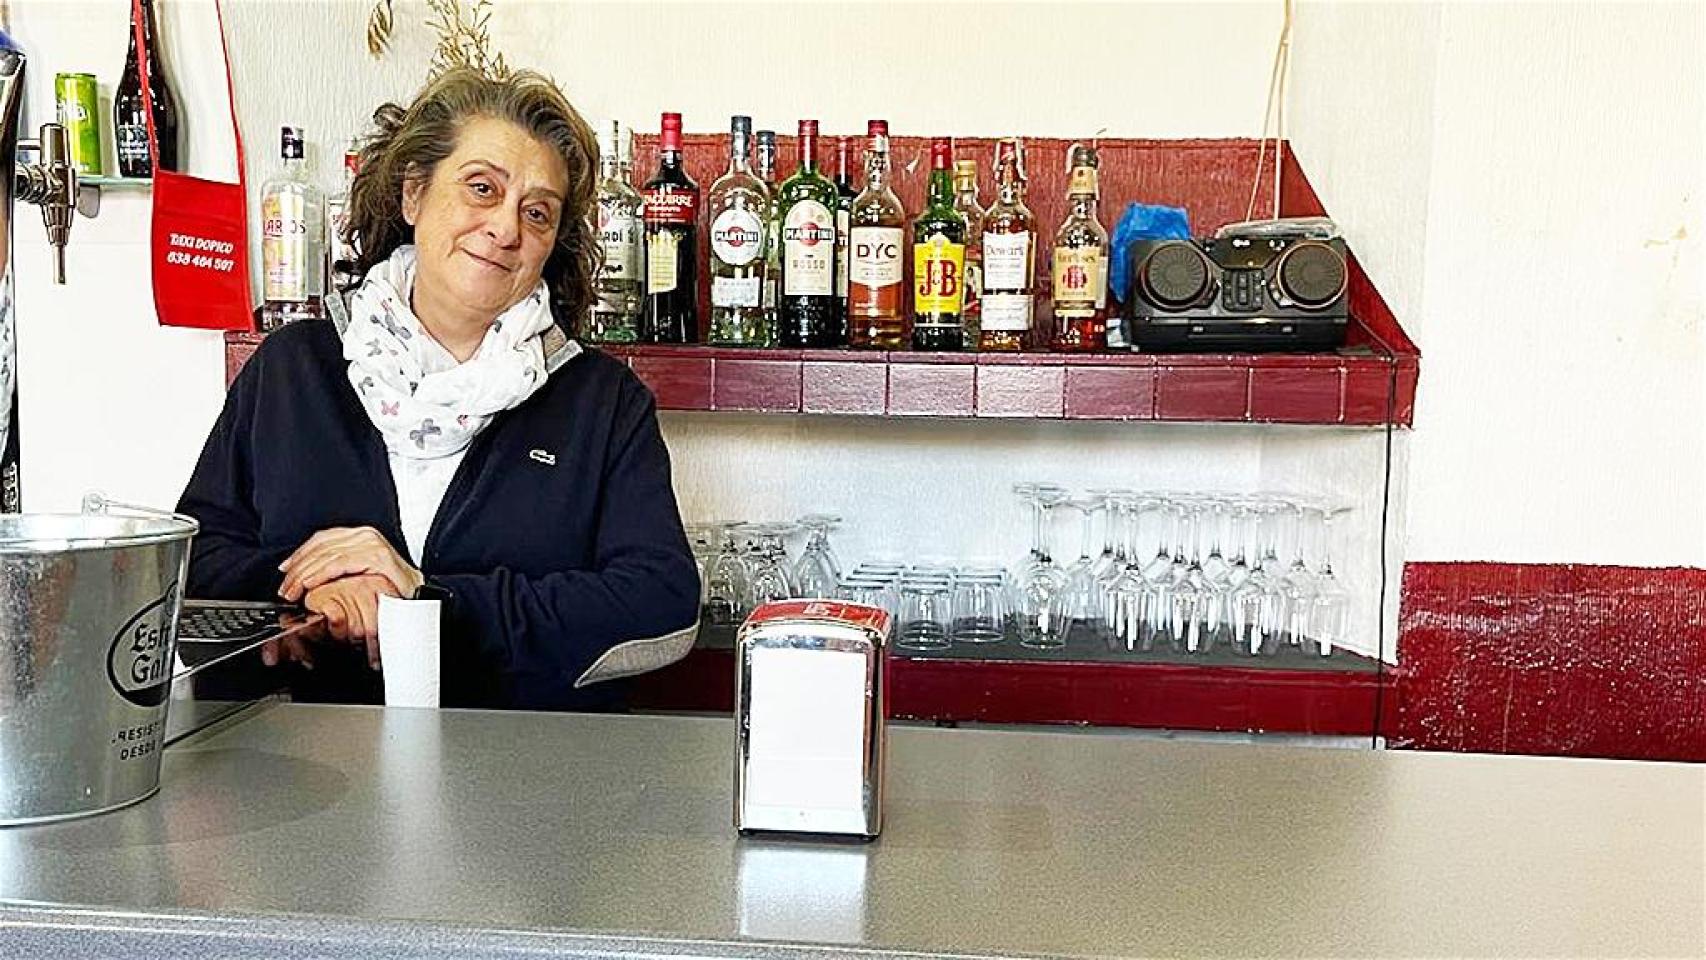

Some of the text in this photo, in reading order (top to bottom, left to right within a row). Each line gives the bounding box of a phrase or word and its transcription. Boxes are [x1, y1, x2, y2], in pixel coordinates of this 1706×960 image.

[715, 231, 758, 242] MARTINI
[785, 228, 833, 241] MARTINI
[169, 232, 234, 254] TAXI DOPICO
[857, 243, 897, 259] DYC
